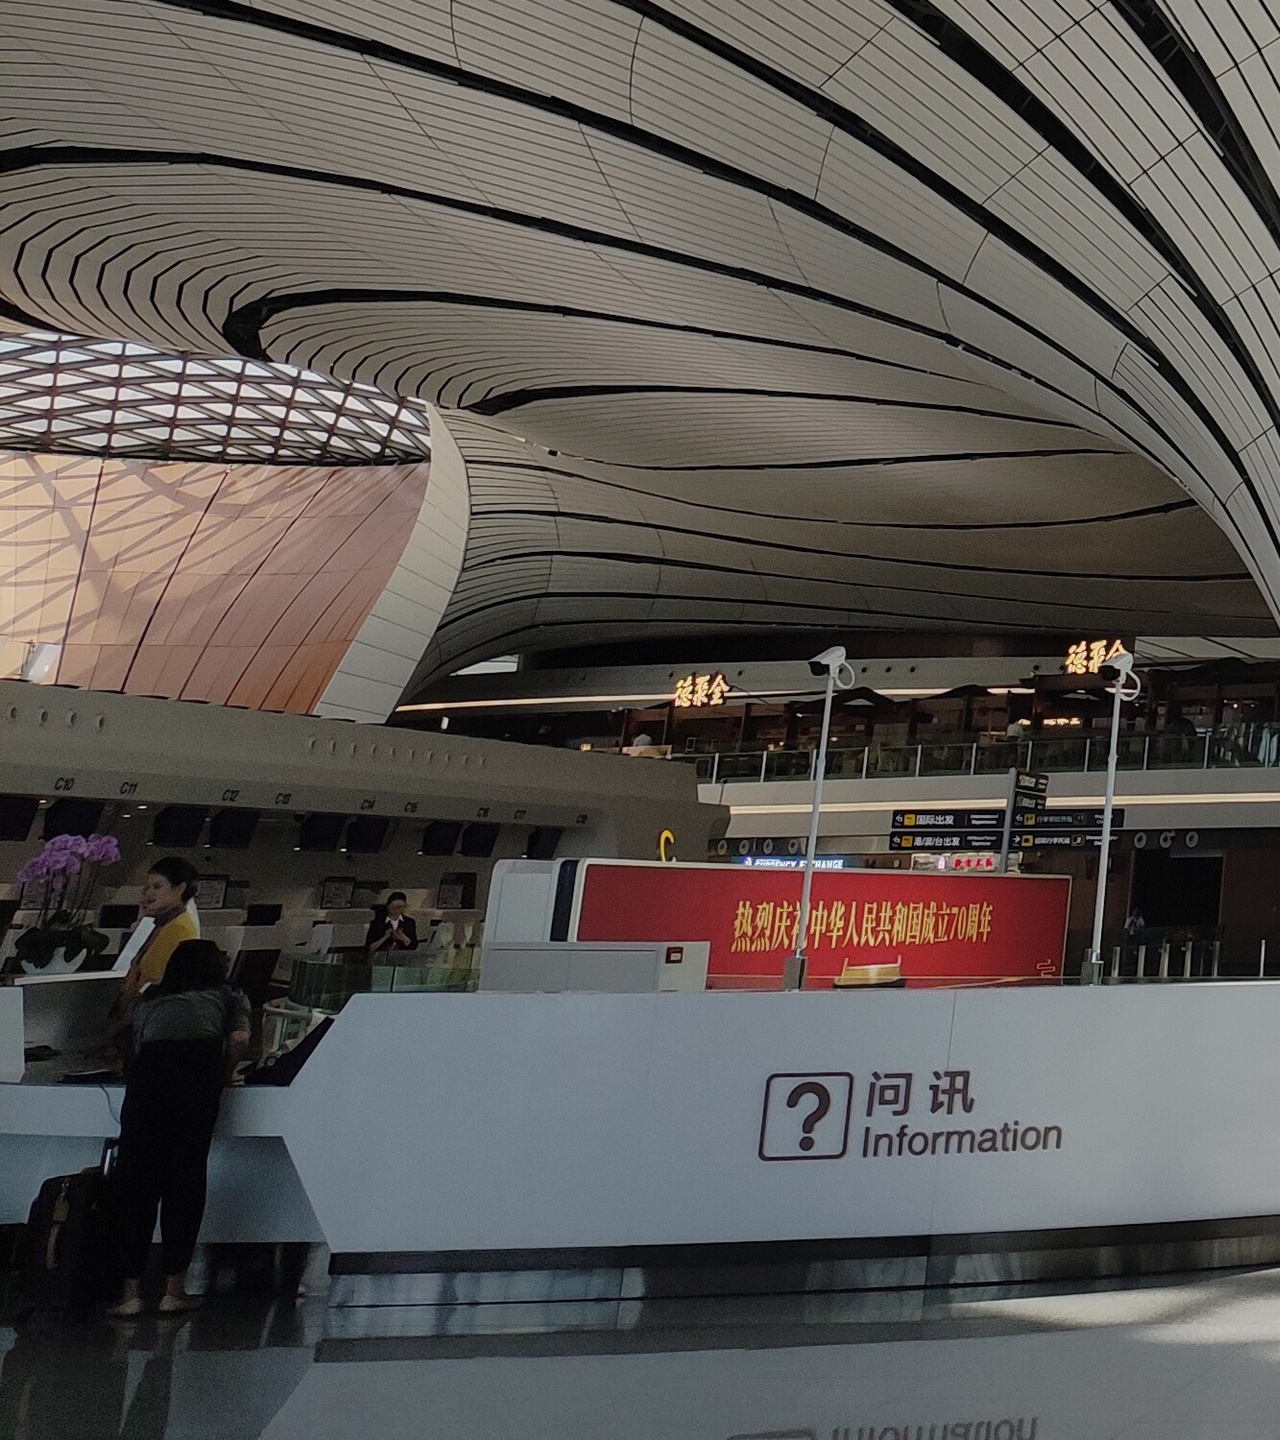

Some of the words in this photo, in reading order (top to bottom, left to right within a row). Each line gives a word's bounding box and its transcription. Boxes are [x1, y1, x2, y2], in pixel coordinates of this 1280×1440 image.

[54, 777, 75, 791] C10
[120, 782, 139, 795] C11
[221, 789, 240, 802] C12
[275, 793, 292, 805] C13
[916, 814, 954, 825] 国际出发
[799, 860, 843, 869] EHANGE
[866, 1071, 975, 1117] 问讯
[862, 1120, 1063, 1158] Information
